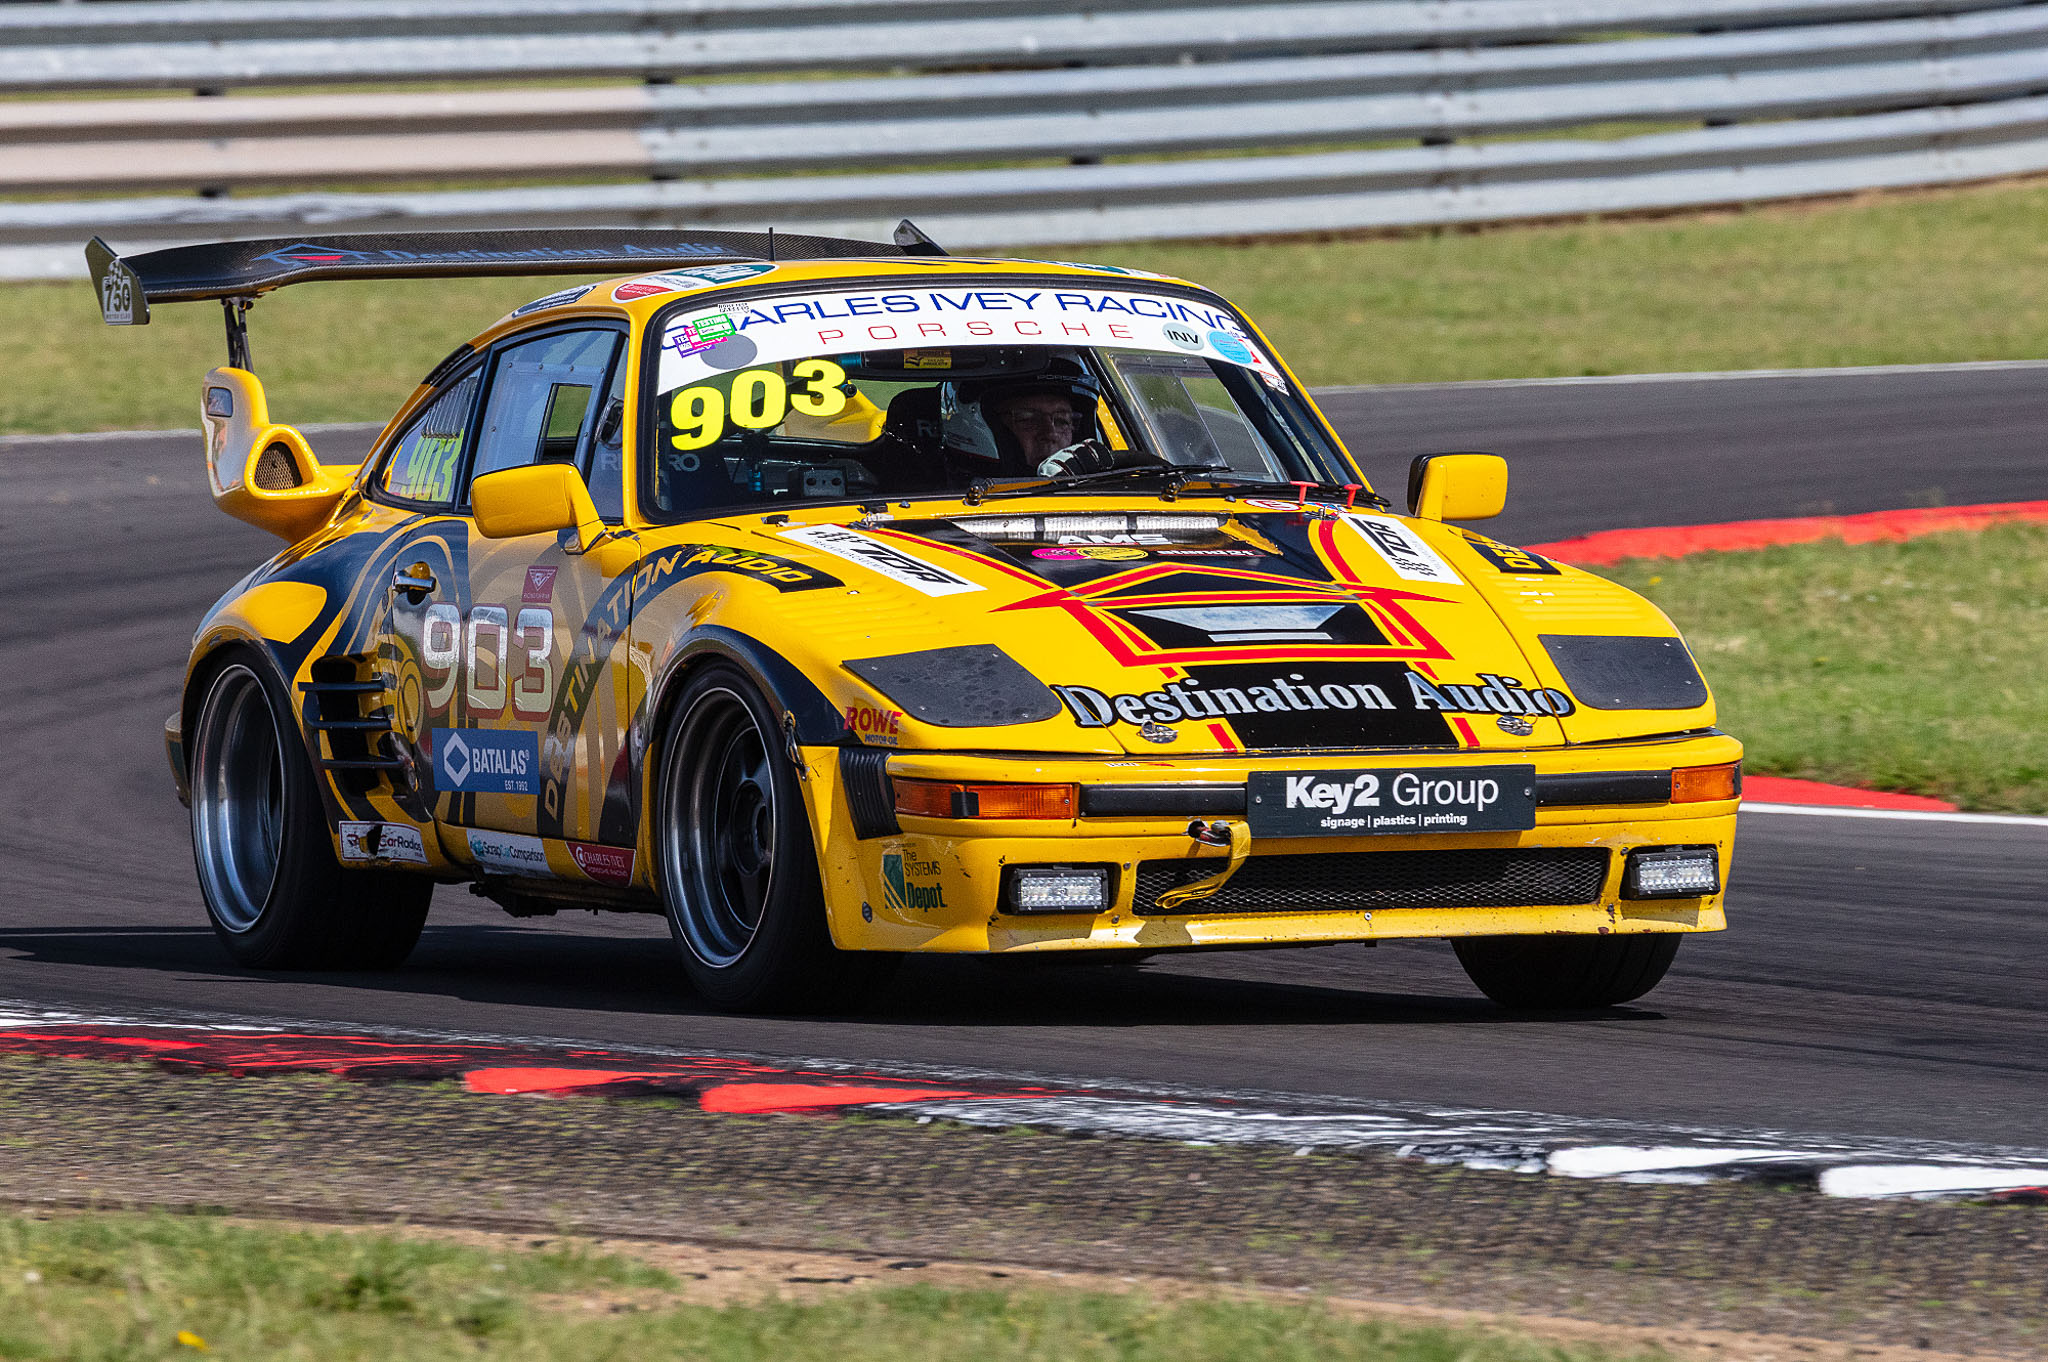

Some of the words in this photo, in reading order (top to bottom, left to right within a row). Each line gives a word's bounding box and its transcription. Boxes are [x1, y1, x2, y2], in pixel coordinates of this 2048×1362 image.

[105, 283, 130, 312] 750
[930, 292, 1043, 310] IVEY
[695, 314, 728, 328] TESTING
[818, 321, 1134, 345] PORSCHE
[1166, 329, 1200, 344] INV
[670, 359, 847, 451] 903
[1057, 533, 1173, 545] AMS
[681, 550, 814, 583] AUDIO
[421, 601, 554, 722] 903
[1059, 674, 1397, 727] Destination
[1404, 671, 1573, 715] Audio
[843, 706, 904, 735] ROWE
[1286, 773, 1380, 815] Key2
[1392, 773, 1499, 812] Group
[1320, 815, 1366, 829] signage
[1373, 814, 1416, 827] plastics
[1423, 813, 1468, 826] printing
[902, 849, 917, 861] The
[905, 861, 942, 877] SYSTEMS
